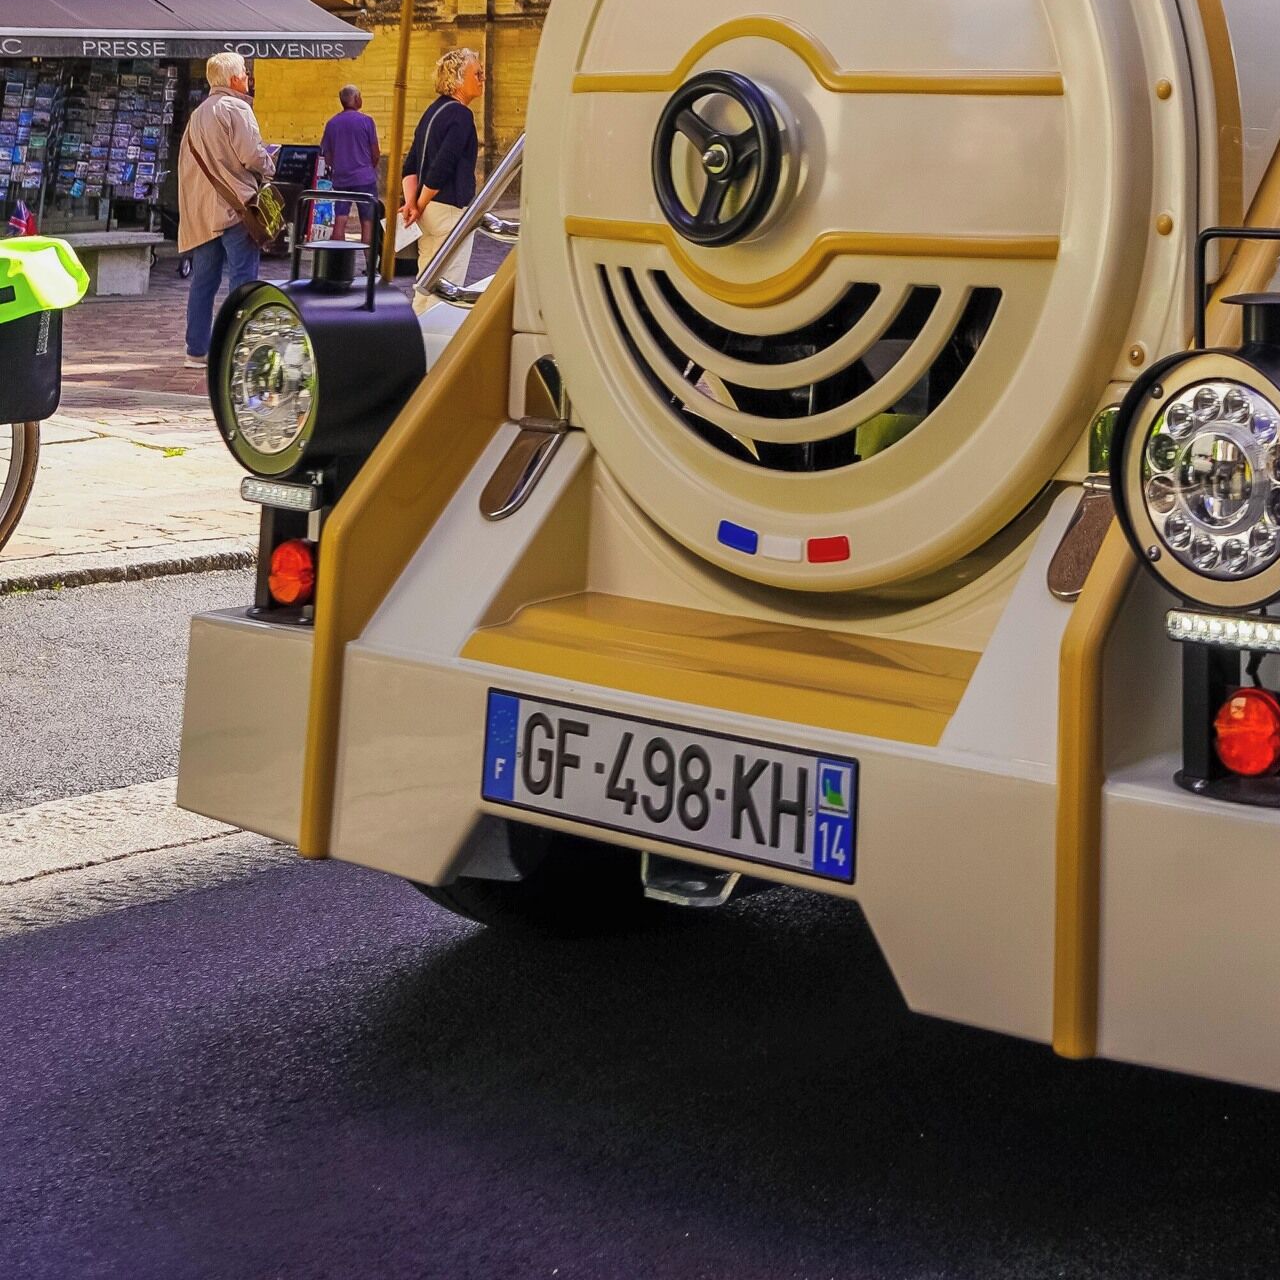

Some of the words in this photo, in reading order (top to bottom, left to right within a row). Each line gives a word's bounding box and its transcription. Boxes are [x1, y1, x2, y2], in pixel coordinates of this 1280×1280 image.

[0, 38, 22, 54] C
[82, 40, 166, 57] PRESSE
[223, 43, 345, 58] SOUVENIRS
[495, 758, 506, 780] F
[521, 712, 809, 854] GF-498-KH
[818, 821, 846, 866] 14
